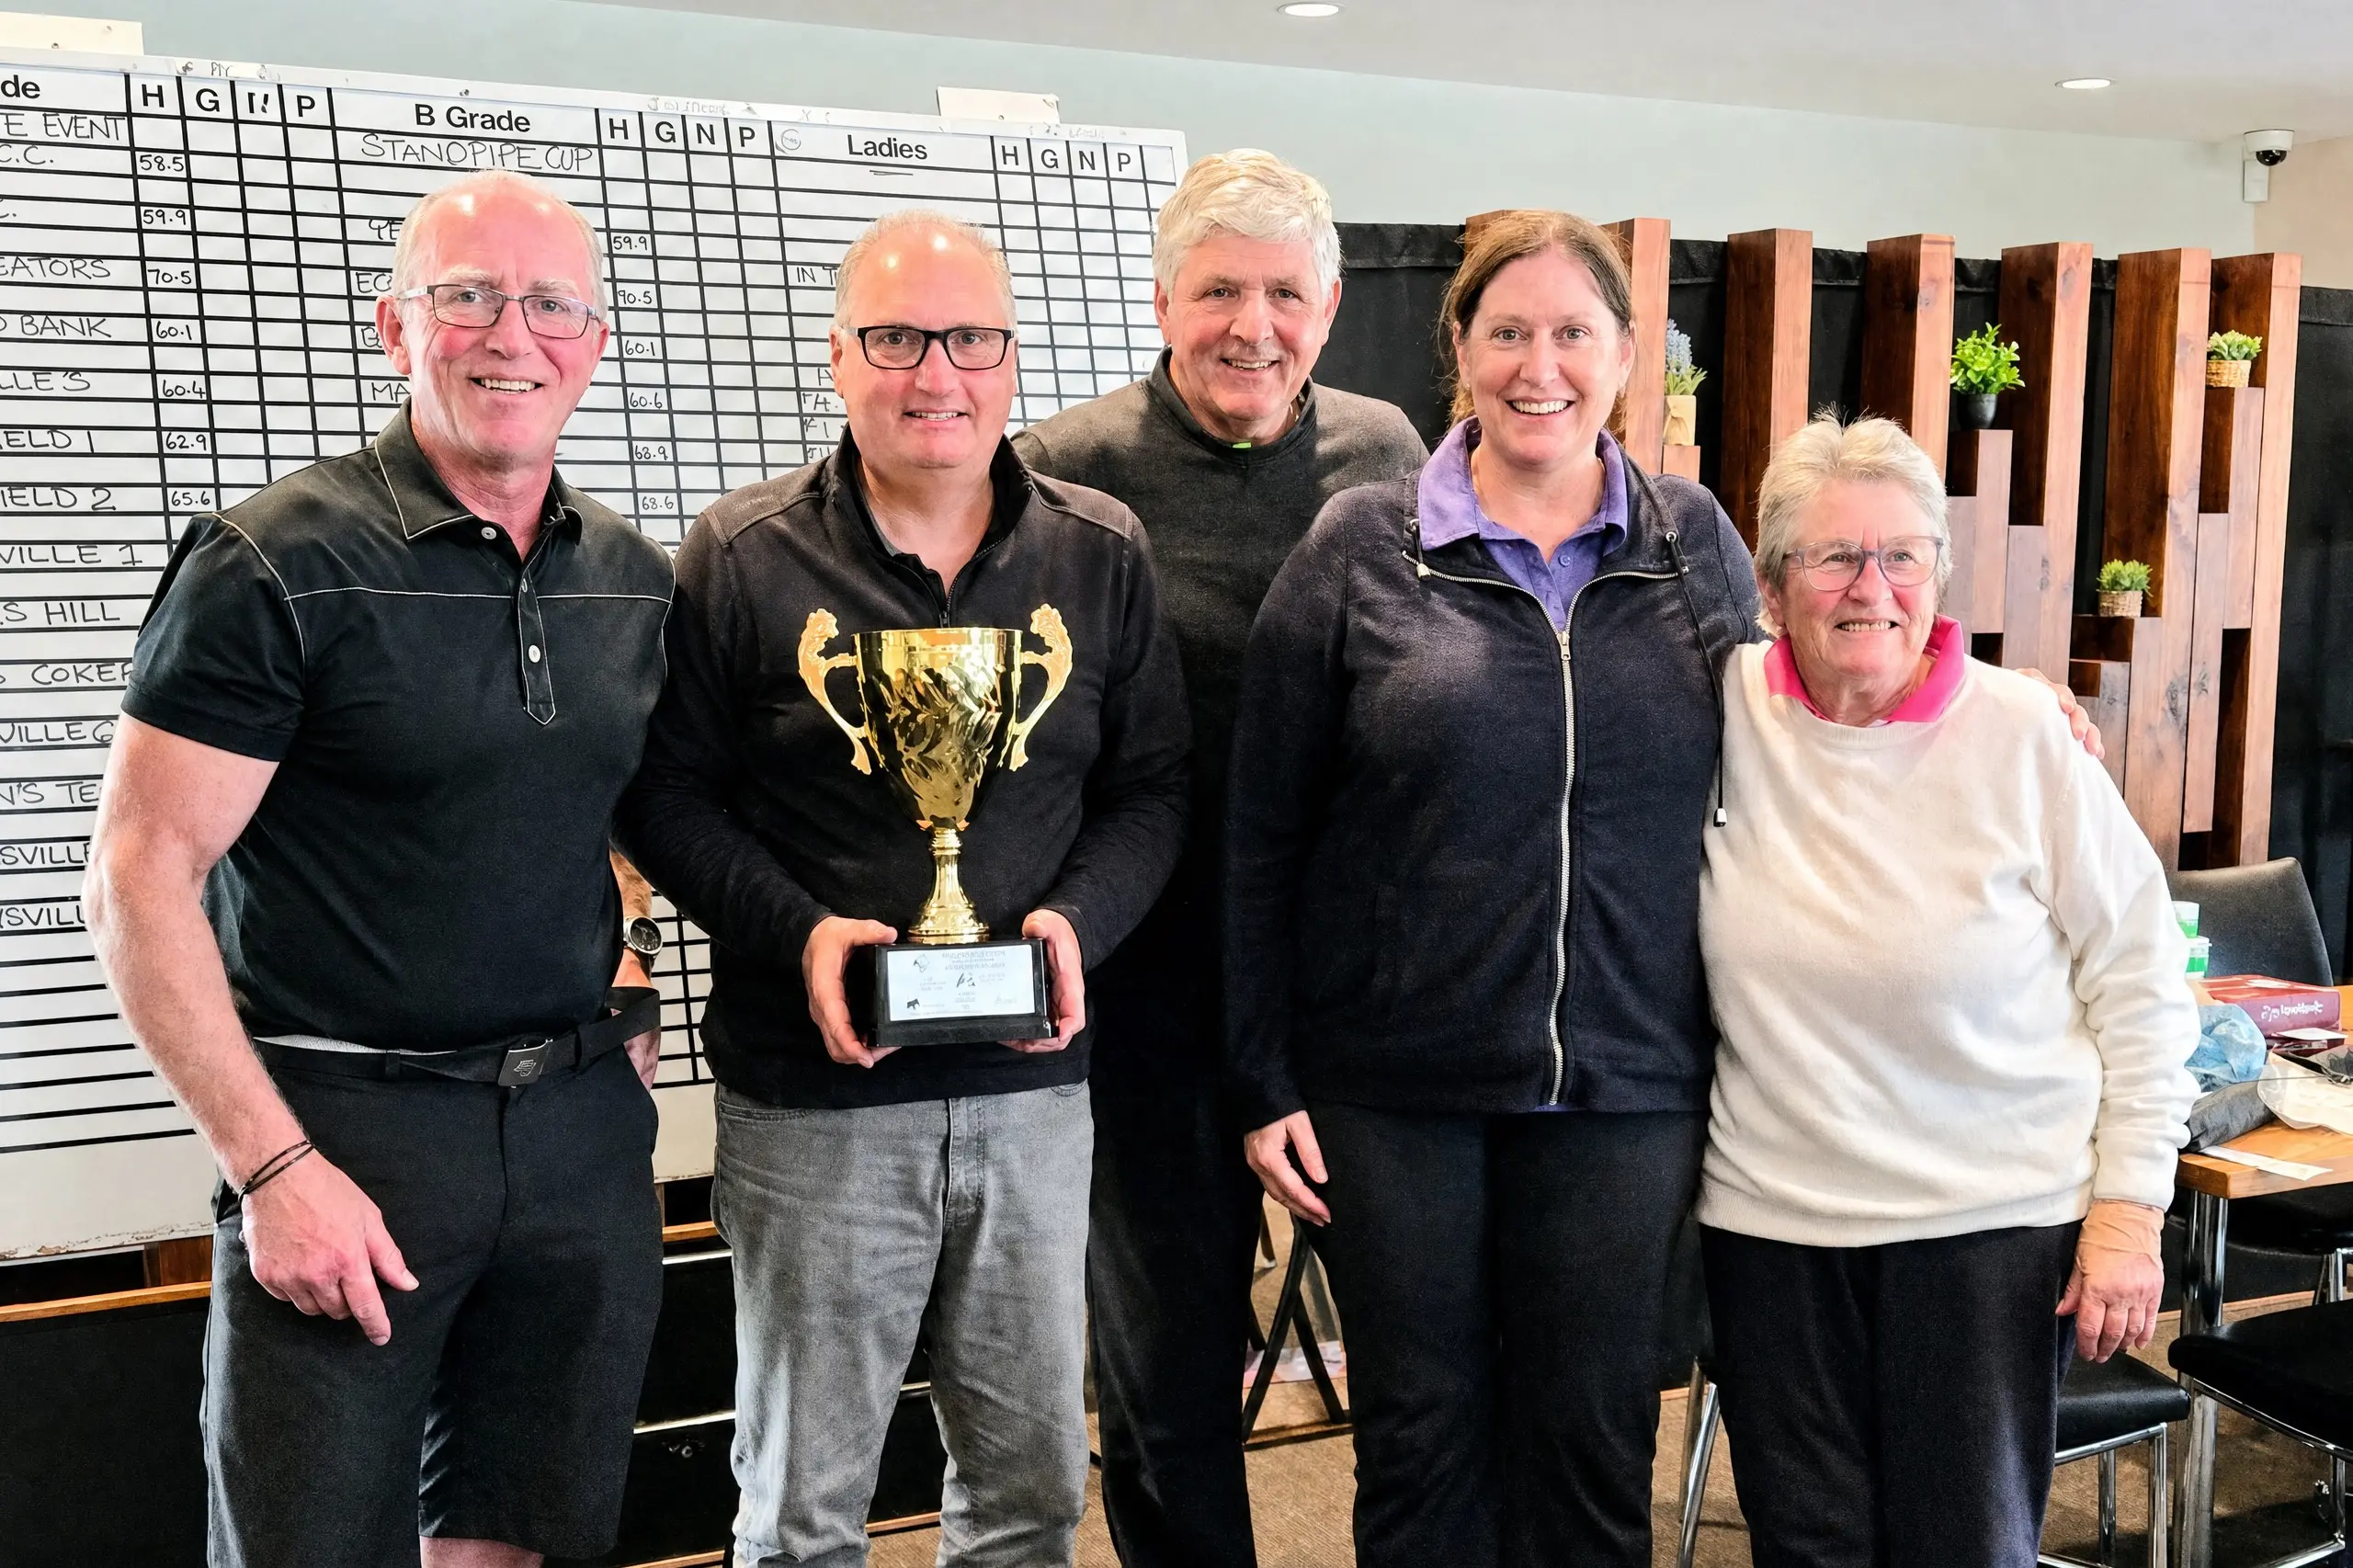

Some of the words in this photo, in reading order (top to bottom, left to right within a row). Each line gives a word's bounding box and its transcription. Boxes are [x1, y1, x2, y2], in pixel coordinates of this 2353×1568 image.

[1, 74, 40, 99] de
[142, 84, 165, 108] H
[196, 88, 220, 112] G
[298, 95, 316, 118] P
[0, 112, 28, 137] E
[42, 112, 125, 141] EVENT
[415, 104, 436, 126] B
[446, 106, 531, 132] Grade
[608, 118, 629, 140] H
[654, 120, 676, 143] G
[696, 123, 716, 145] N
[738, 126, 756, 147] P
[847, 134, 928, 161] Ladies
[1001, 145, 1019, 166] H
[139, 154, 184, 172] 58.5
[545, 145, 593, 172] CUP
[1040, 149, 1059, 169] G
[1078, 150, 1096, 171] N
[1117, 153, 1131, 172] P
[143, 210, 187, 225] 59.9
[612, 235, 648, 251] 59.9
[147, 268, 192, 285] 70.5
[797, 267, 816, 283] IN
[822, 266, 837, 286] T
[618, 290, 653, 305] 90.5
[20, 314, 112, 337] BANK
[156, 321, 192, 340] 60.1
[625, 339, 656, 357] 60.1
[163, 380, 206, 399] 60.4
[630, 392, 663, 409] 60.6
[0, 429, 72, 449] ELD
[87, 430, 95, 453] 1
[165, 431, 207, 451] 62.9
[91, 487, 117, 510] 2
[171, 491, 210, 506] 65.6
[642, 495, 674, 510] 68.6
[119, 544, 142, 565] 1
[45, 602, 120, 625] HILL
